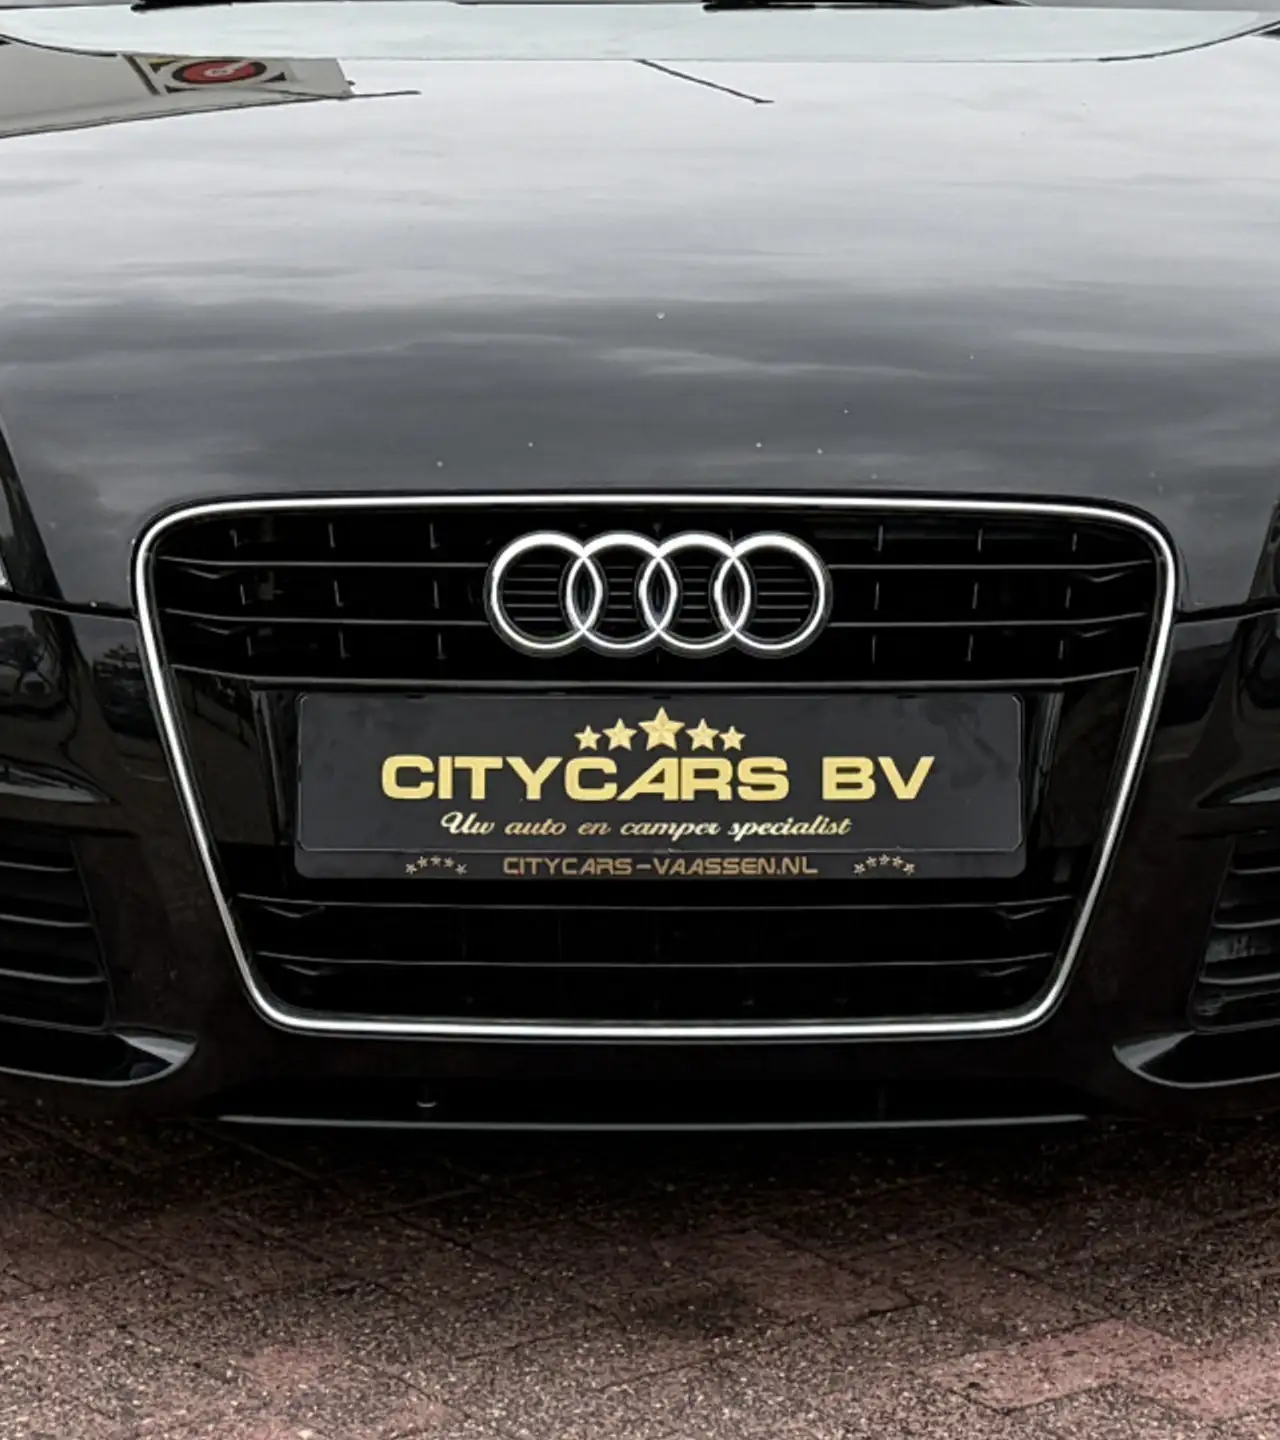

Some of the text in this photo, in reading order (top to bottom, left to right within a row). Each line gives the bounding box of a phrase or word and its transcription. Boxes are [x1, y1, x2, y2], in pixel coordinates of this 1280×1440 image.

[381, 754, 936, 801] CITYCARS BV
[440, 811, 853, 843] Uw auto en camper specialist
[502, 856, 819, 877] CITYCARS-VAASSEN.NL
